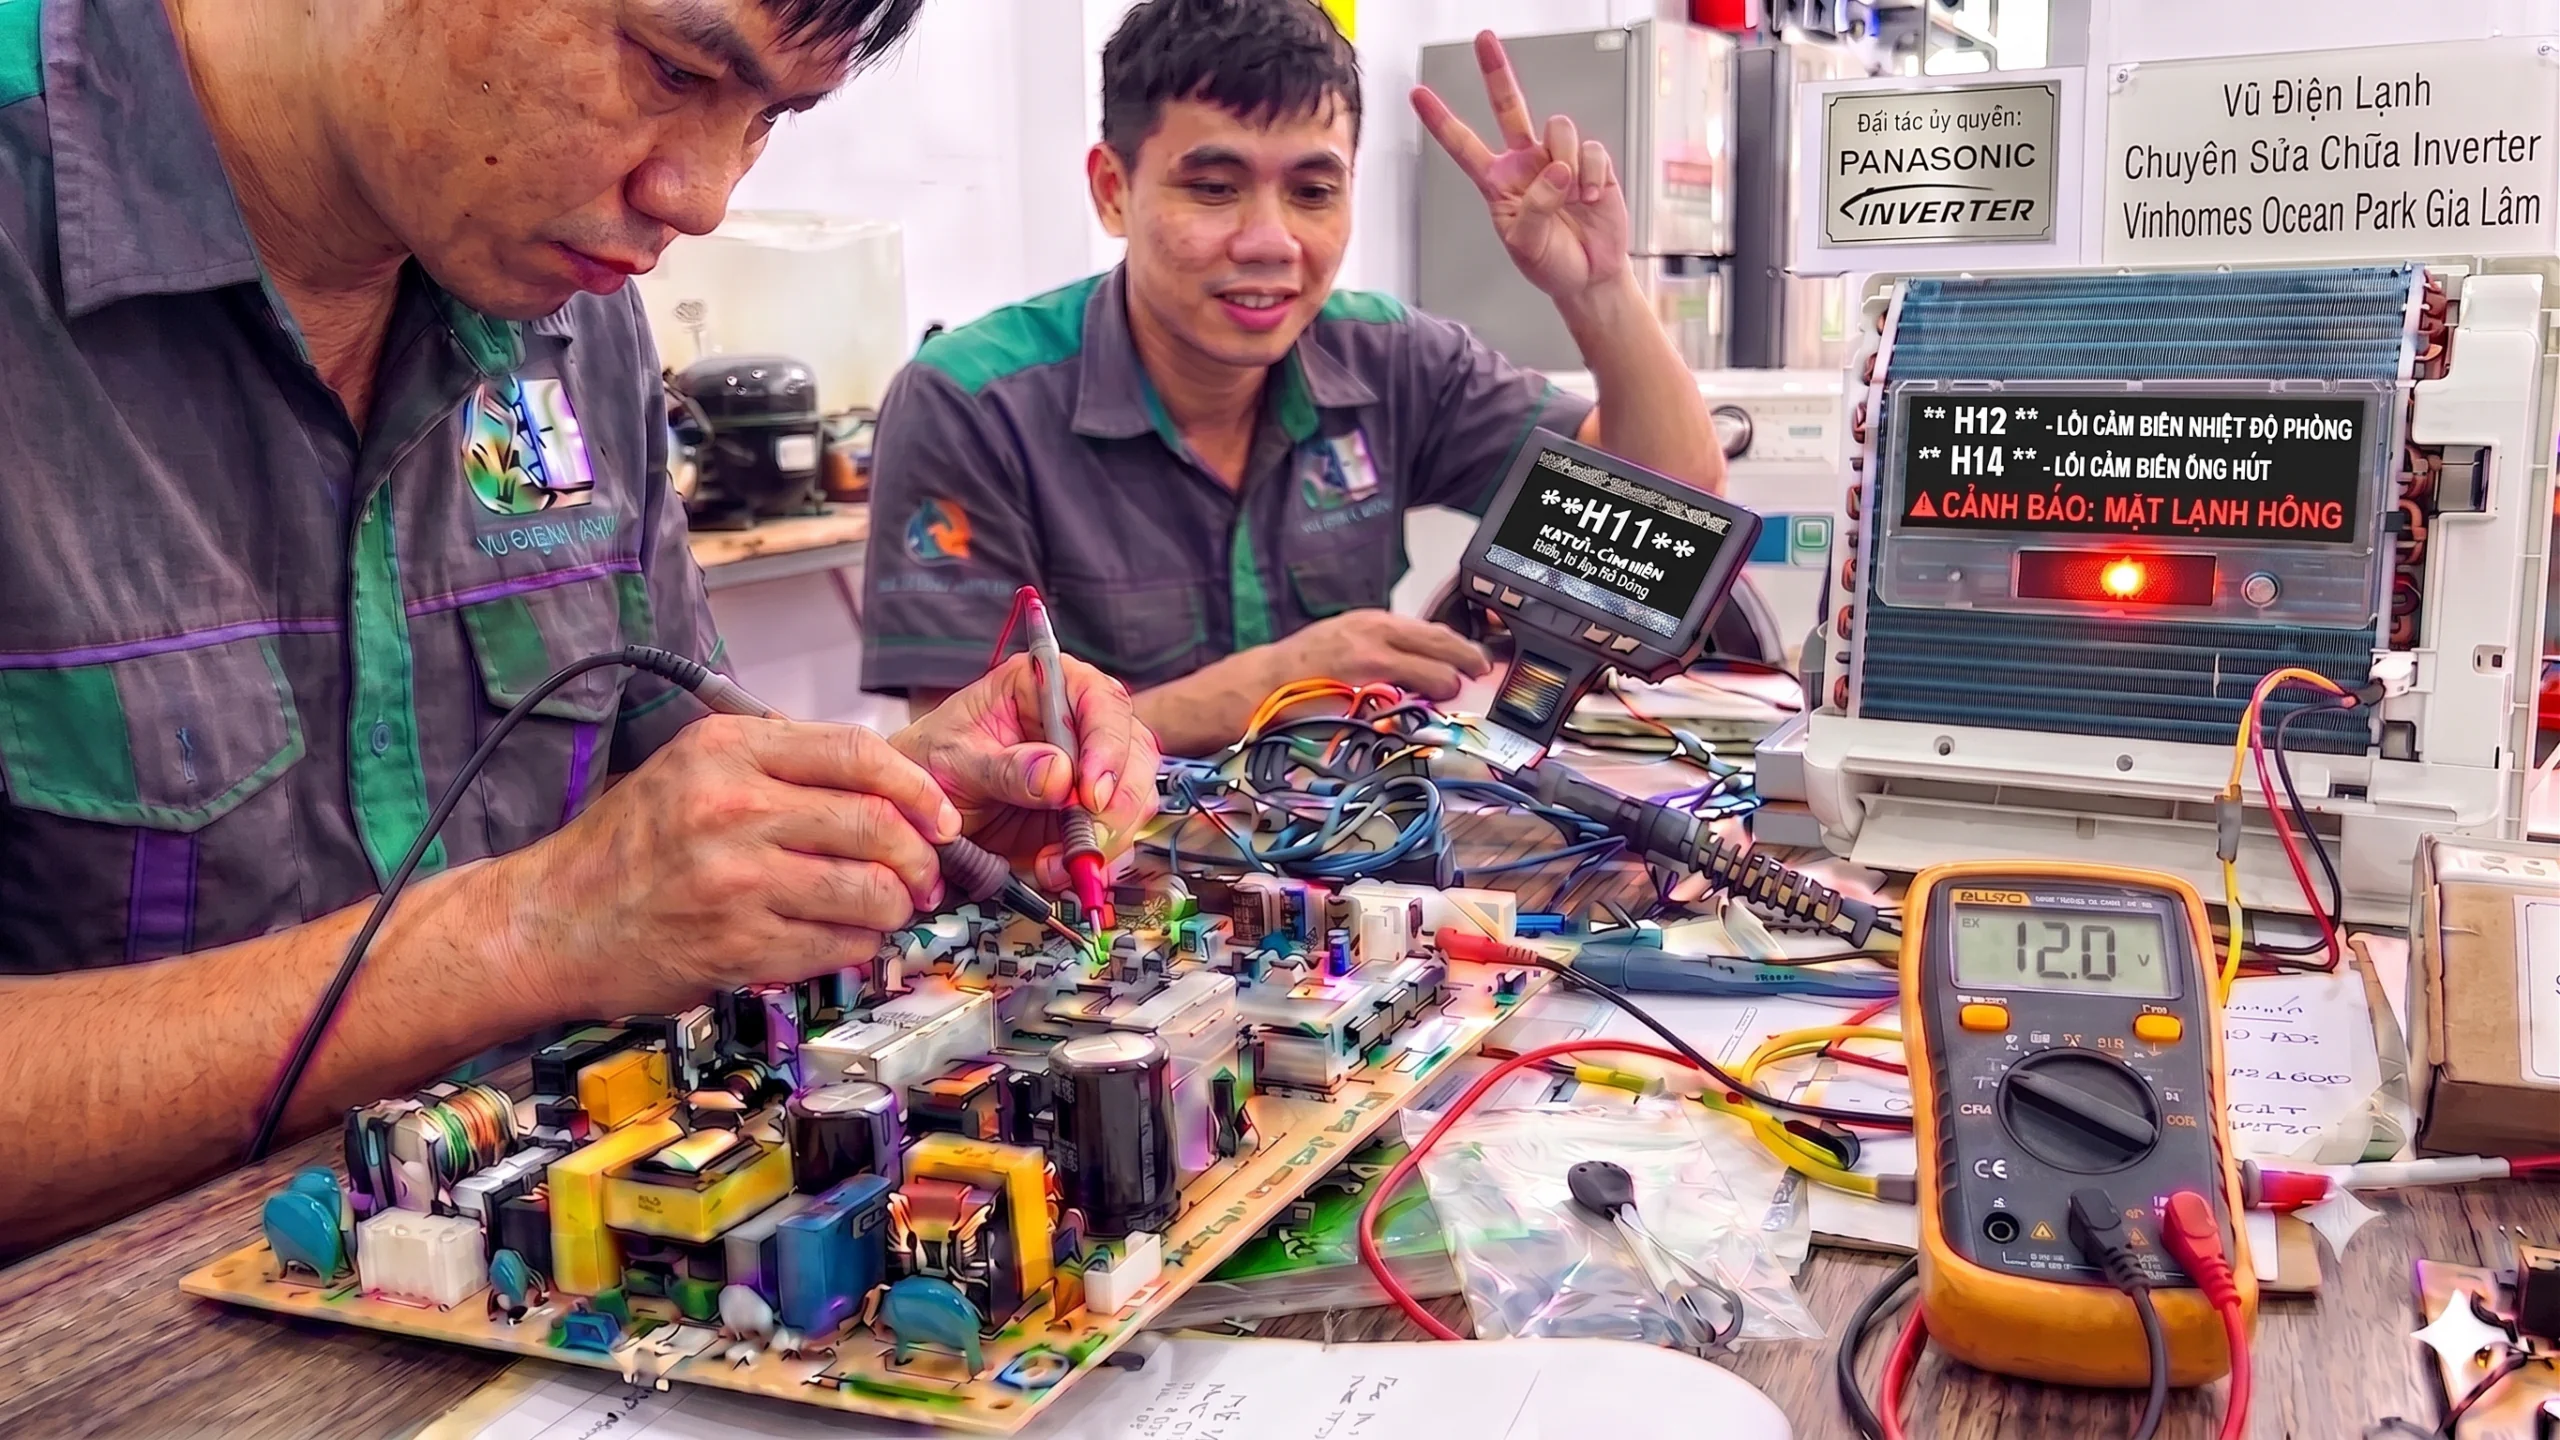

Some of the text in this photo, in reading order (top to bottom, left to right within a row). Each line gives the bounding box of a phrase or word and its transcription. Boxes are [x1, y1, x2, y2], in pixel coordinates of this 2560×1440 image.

[2224, 72, 2430, 122] Vũ Điện Lạnh
[1894, 110, 1923, 131] tác
[1930, 108, 1951, 134] ủy
[1840, 142, 2035, 176] PANASONIC
[2125, 129, 2542, 185] Chuyên Sửa Chữa Inverter
[1857, 199, 2036, 227] INVERTER
[2123, 185, 2540, 240] Vinhomes Ocean Park Gia Lâm
[1954, 406, 2008, 435] H12
[2092, 409, 2135, 436] CẢM
[2188, 412, 2247, 444] NHIỆT
[2248, 413, 2279, 445] ĐỘ
[2283, 413, 2353, 441] PHÒNG
[1950, 444, 2005, 477] H14
[2089, 449, 2132, 478] CẢM
[2232, 450, 2273, 482] HÚT
[1942, 483, 2342, 533] CẢNH BÁO: MẶT LẠNH HỎNG
[2016, 919, 2117, 983] 12.0
